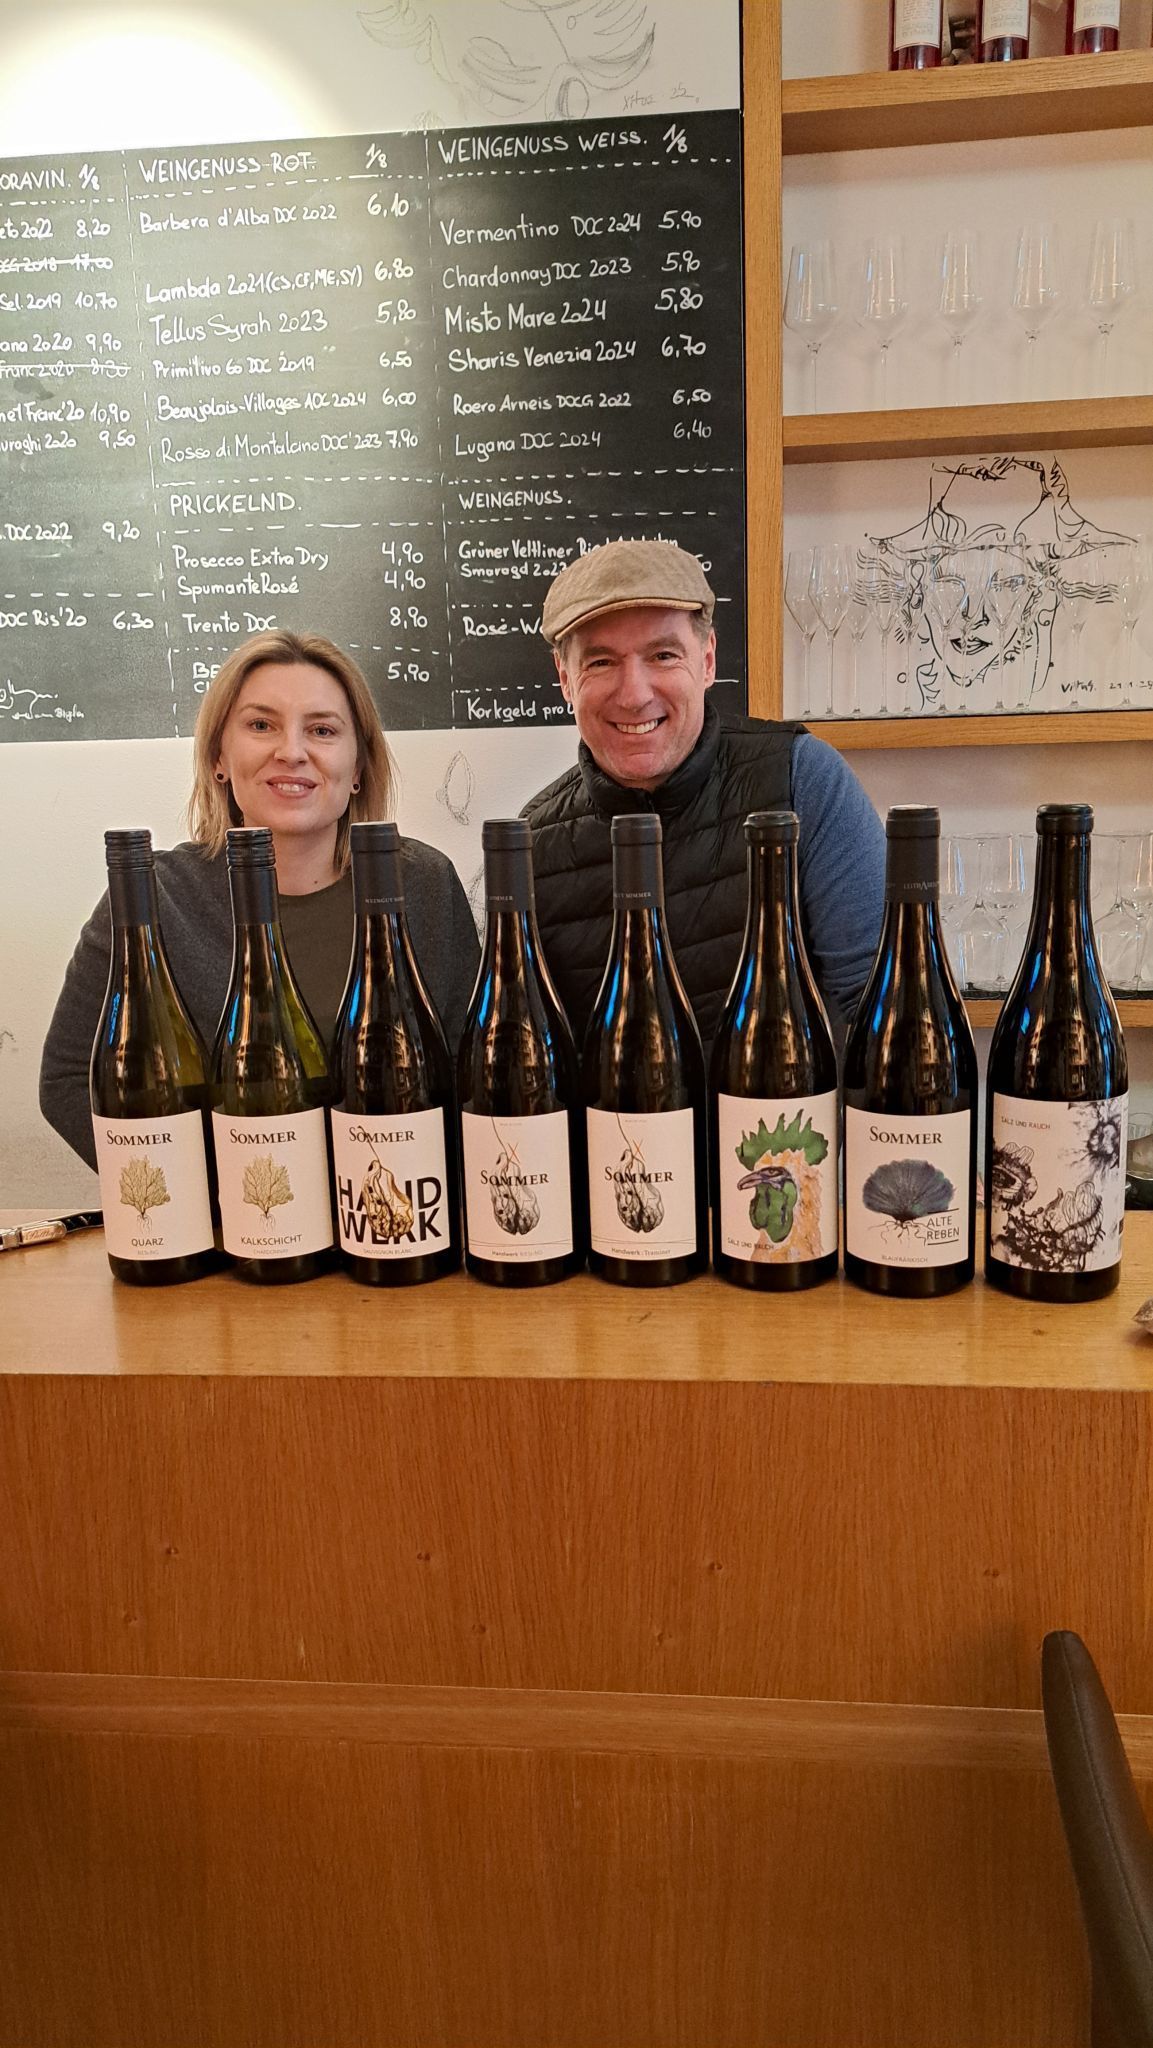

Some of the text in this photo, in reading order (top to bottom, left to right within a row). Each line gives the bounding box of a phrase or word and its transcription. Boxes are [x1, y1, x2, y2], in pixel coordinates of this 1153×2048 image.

[438, 123, 688, 164] WEINGENUSS WEISS. 1/8
[138, 143, 388, 184] WEINGENUSS ROT. 1/8
[0, 163, 100, 191] ORAVIN. 1/8
[139, 211, 209, 234] Barbera
[217, 205, 269, 226] d'Alba
[302, 204, 338, 221] 2022
[367, 192, 411, 217] 6,10
[20, 217, 54, 240] 2022
[76, 217, 111, 240] 8,20
[439, 210, 702, 246] Vermentino DOC 2024 5,90
[145, 276, 221, 305] Lambda
[374, 258, 415, 282] 6,80
[442, 265, 551, 289] Chardonnay
[551, 262, 582, 279] DOC
[588, 257, 632, 278] 2023
[26, 292, 62, 310] 2019
[74, 290, 118, 312] 10,70
[444, 286, 704, 336] Misto Mare 2024 5,80
[149, 299, 417, 347] Tellus Syrah 2023 5,80
[32, 333, 73, 352] 2020
[85, 333, 122, 354] 9,90
[448, 334, 707, 373] Sharis Venezia 2024 6,70
[153, 355, 221, 379] Primitivo
[278, 351, 316, 372] 2019
[378, 351, 413, 370] 6,50
[332, 391, 367, 408] 2024
[382, 388, 417, 408] 6,00
[453, 393, 496, 416] Roero
[499, 394, 552, 413] Arneis
[598, 392, 632, 408] 2022
[90, 401, 130, 425] 10,90
[44, 430, 77, 449] 2020
[98, 429, 136, 450] 9,50
[161, 437, 211, 463] Rosso
[216, 440, 231, 457] di
[234, 431, 320, 458] Montalcino
[455, 419, 713, 463] Lugana DOC 2024 6,40
[169, 494, 302, 518] PRICKELND.
[458, 490, 573, 511] WEINGENUSS.
[4, 520, 141, 543] DOC 2022 9,20
[172, 541, 424, 571] Prosecco Extra Dry 4,90
[511, 539, 573, 559] Veltliner
[260, 573, 300, 594] Rosé
[384, 569, 426, 592] 4,90
[460, 562, 528, 580] Smaragd
[112, 610, 154, 631] 6,30
[182, 606, 428, 634] Trento DOC 8,90
[387, 662, 430, 682] 5,90
[467, 697, 537, 722] Korkgeld
[542, 706, 564, 720] pro
[338, 1175, 442, 1213] HD
[926, 1227, 960, 1241] REBEN
[927, 1216, 953, 1228] ALTE
[131, 1238, 164, 1247] QUARZ
[240, 1234, 303, 1246] KALKSCHICHT
